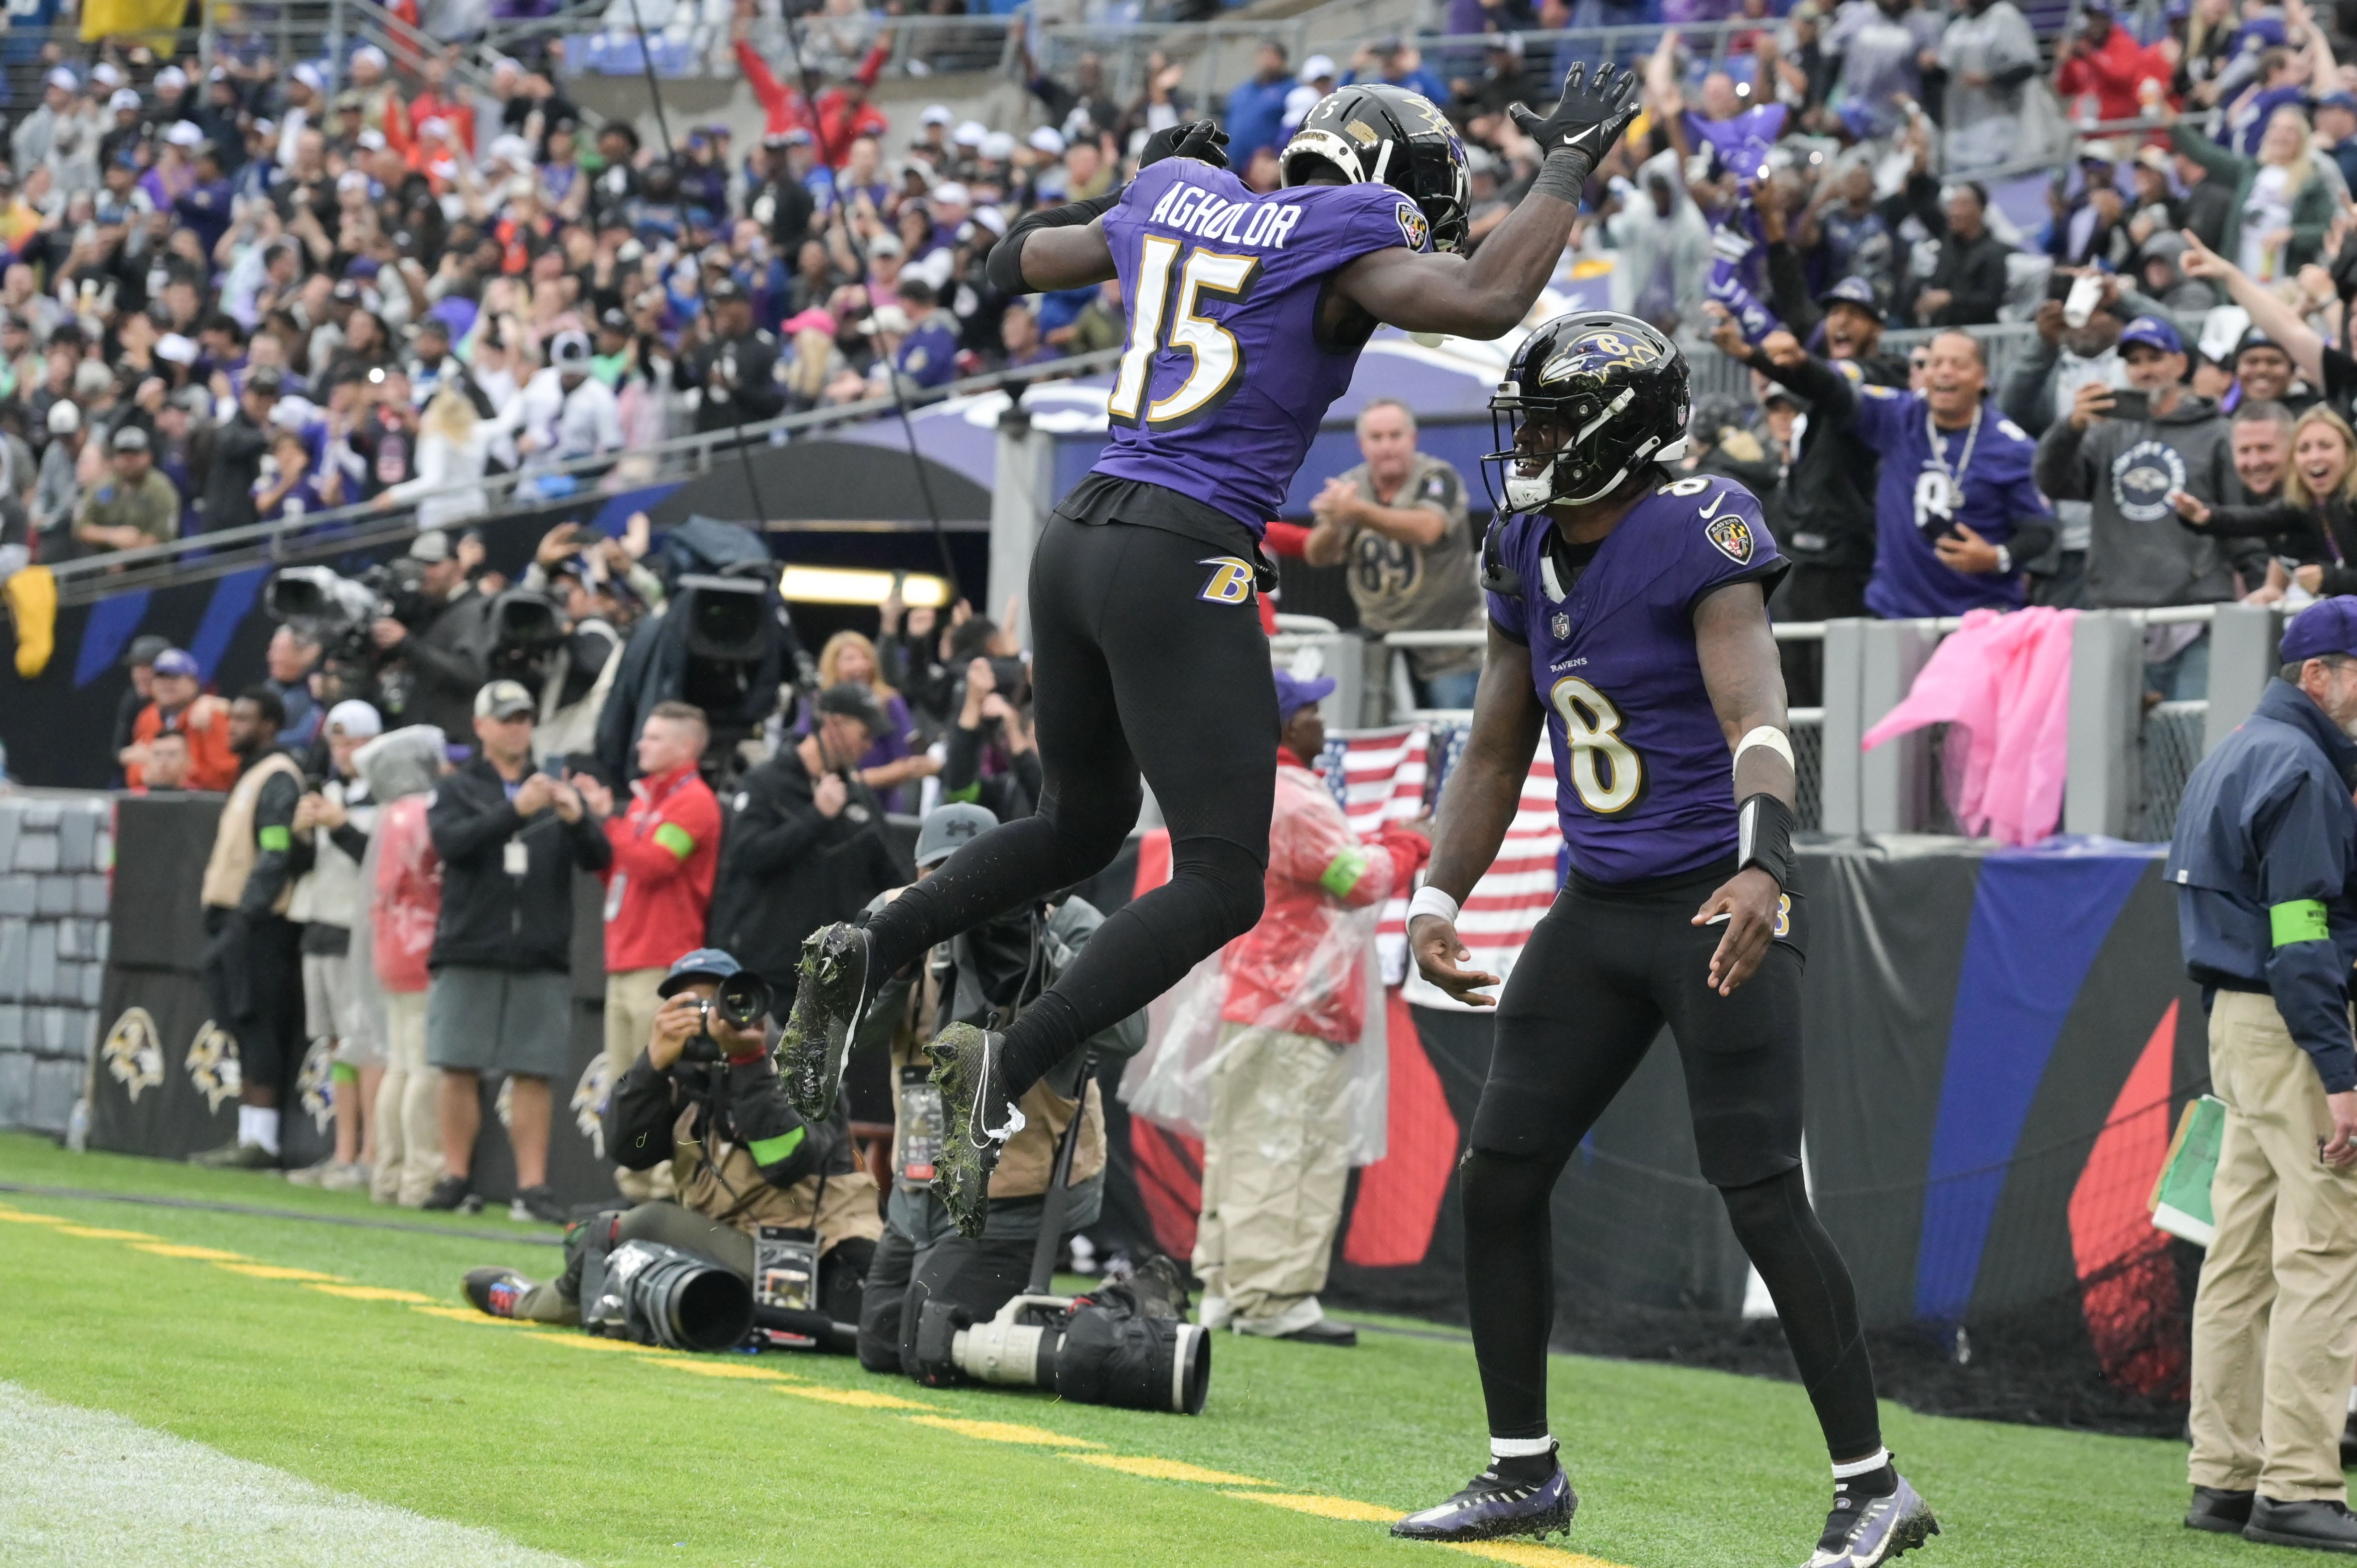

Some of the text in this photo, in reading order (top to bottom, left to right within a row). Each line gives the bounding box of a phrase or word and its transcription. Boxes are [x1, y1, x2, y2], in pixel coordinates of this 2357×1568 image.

[1150, 181, 1302, 249] AGHOLOR
[1108, 234, 1262, 430] 15
[1710, 518, 1740, 532] RAVENS
[1195, 556, 1253, 605] B
[1255, 562, 1269, 573] I-FIT
[1350, 529, 1424, 603] 89
[1549, 657, 1588, 673] RAVENS
[1551, 676, 1645, 815] 8
